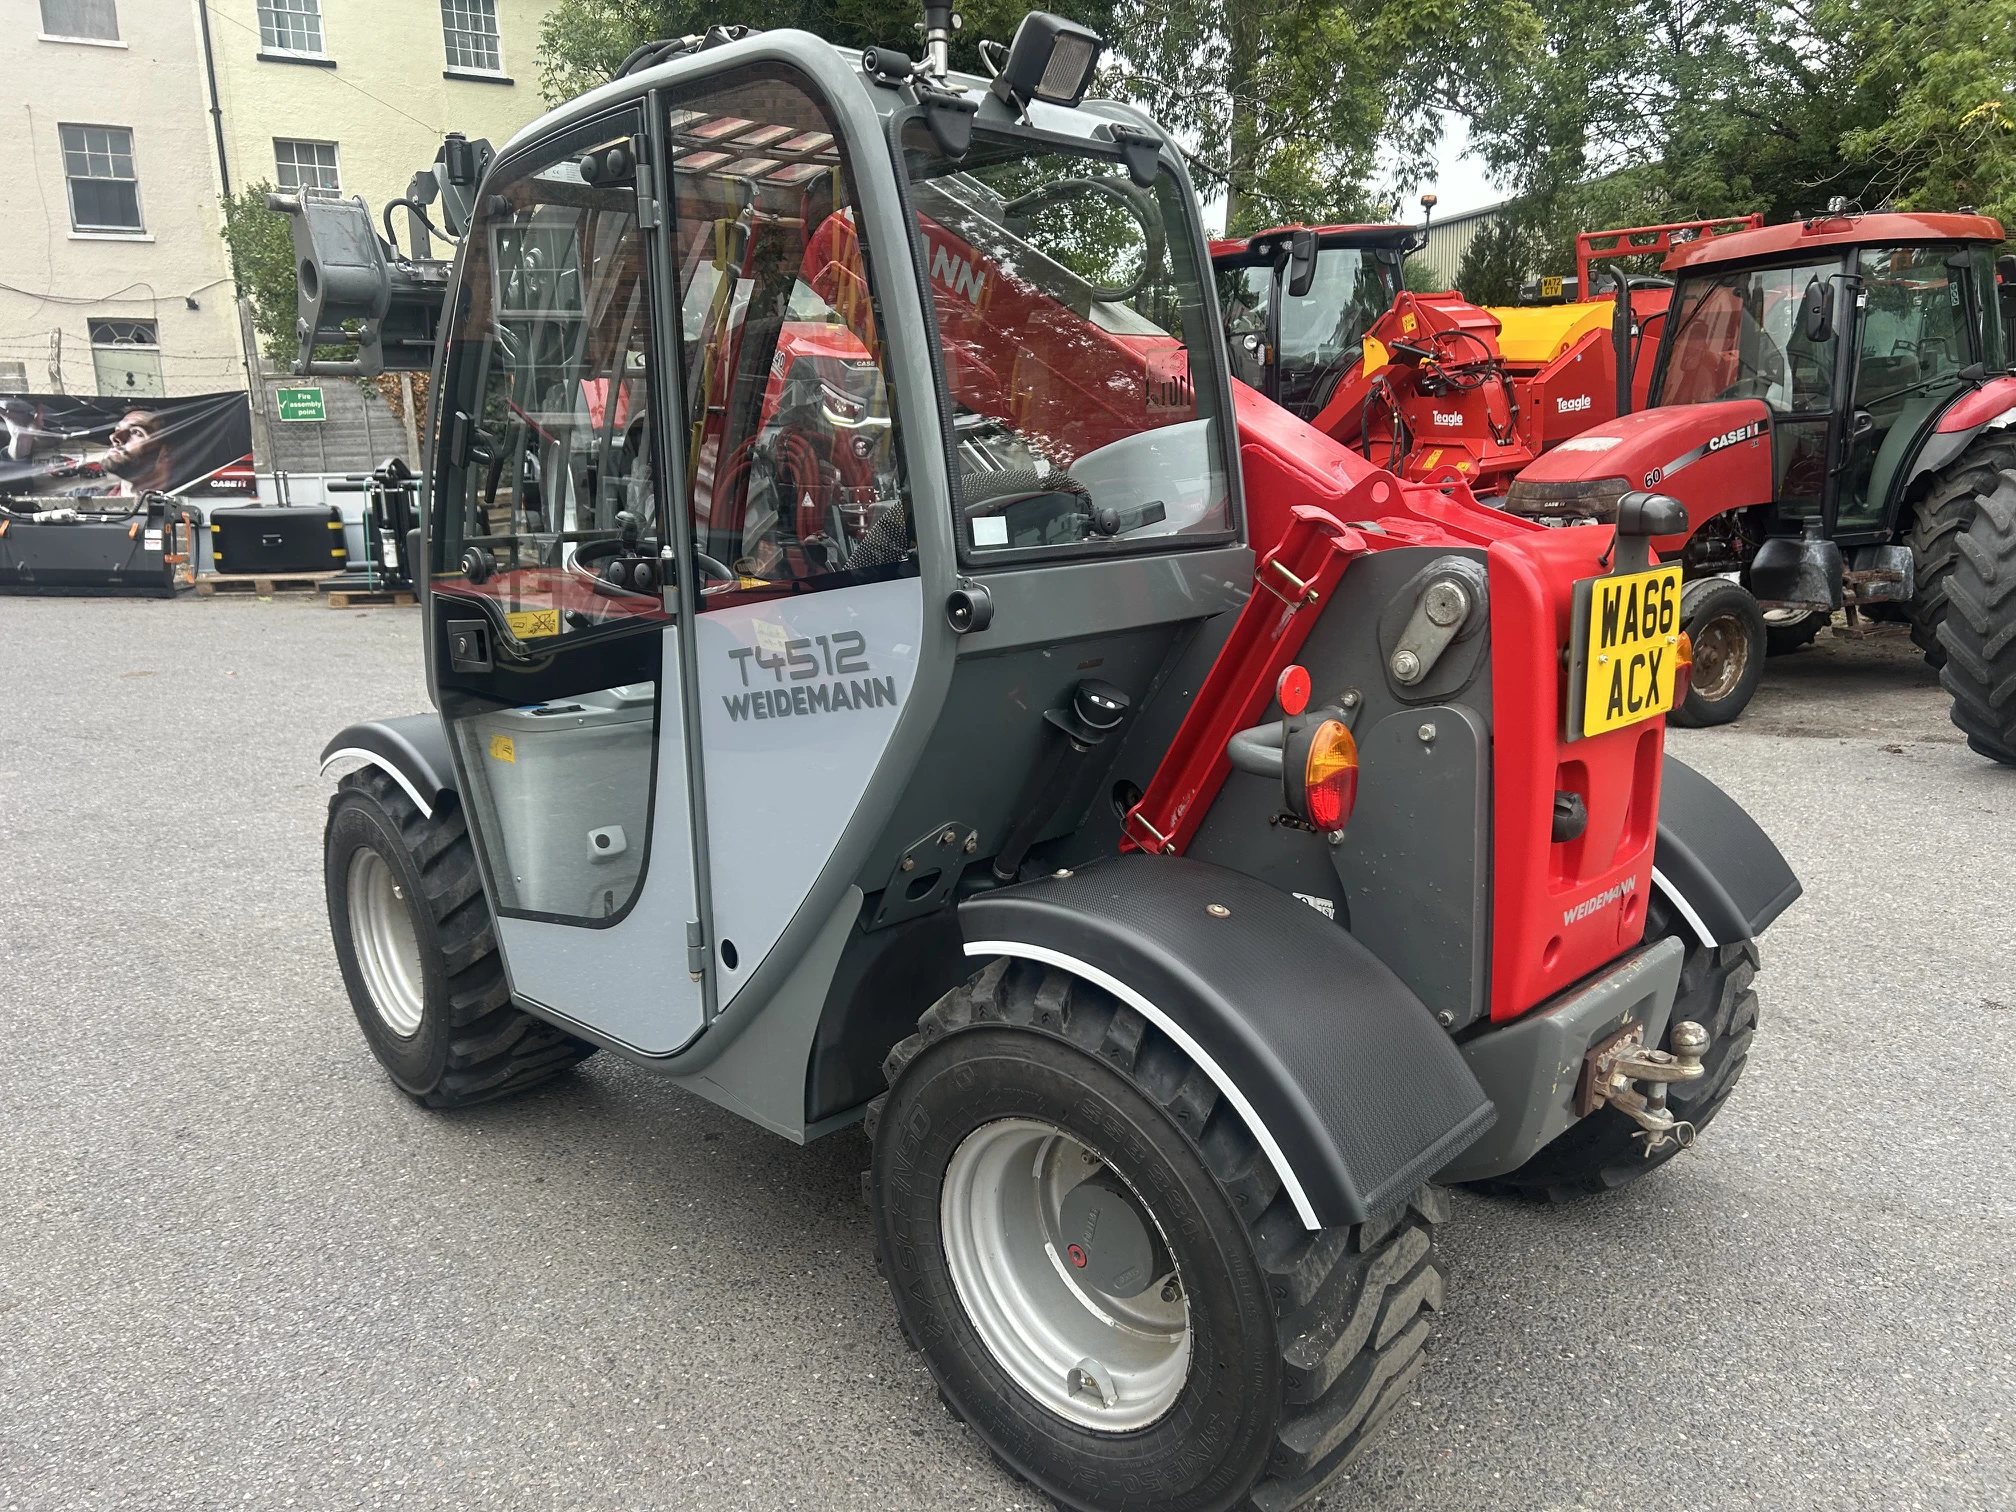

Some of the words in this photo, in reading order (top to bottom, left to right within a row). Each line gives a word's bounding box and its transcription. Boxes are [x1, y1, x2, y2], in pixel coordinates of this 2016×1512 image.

[290, 401, 322, 409] assembly
[1432, 410, 1463, 427] Teagle
[1557, 394, 1591, 412] Teagle
[1709, 427, 1746, 451] CASE
[210, 480, 237, 488] CASE
[1644, 467, 1661, 489] 60
[1601, 576, 1675, 649] WA66
[728, 630, 869, 687] T4512
[722, 675, 897, 722] WEIDEMANN
[1606, 647, 1663, 720] ACX
[1563, 874, 1636, 927] WEIDEMANN
[892, 1103, 931, 1308] ASCENSO
